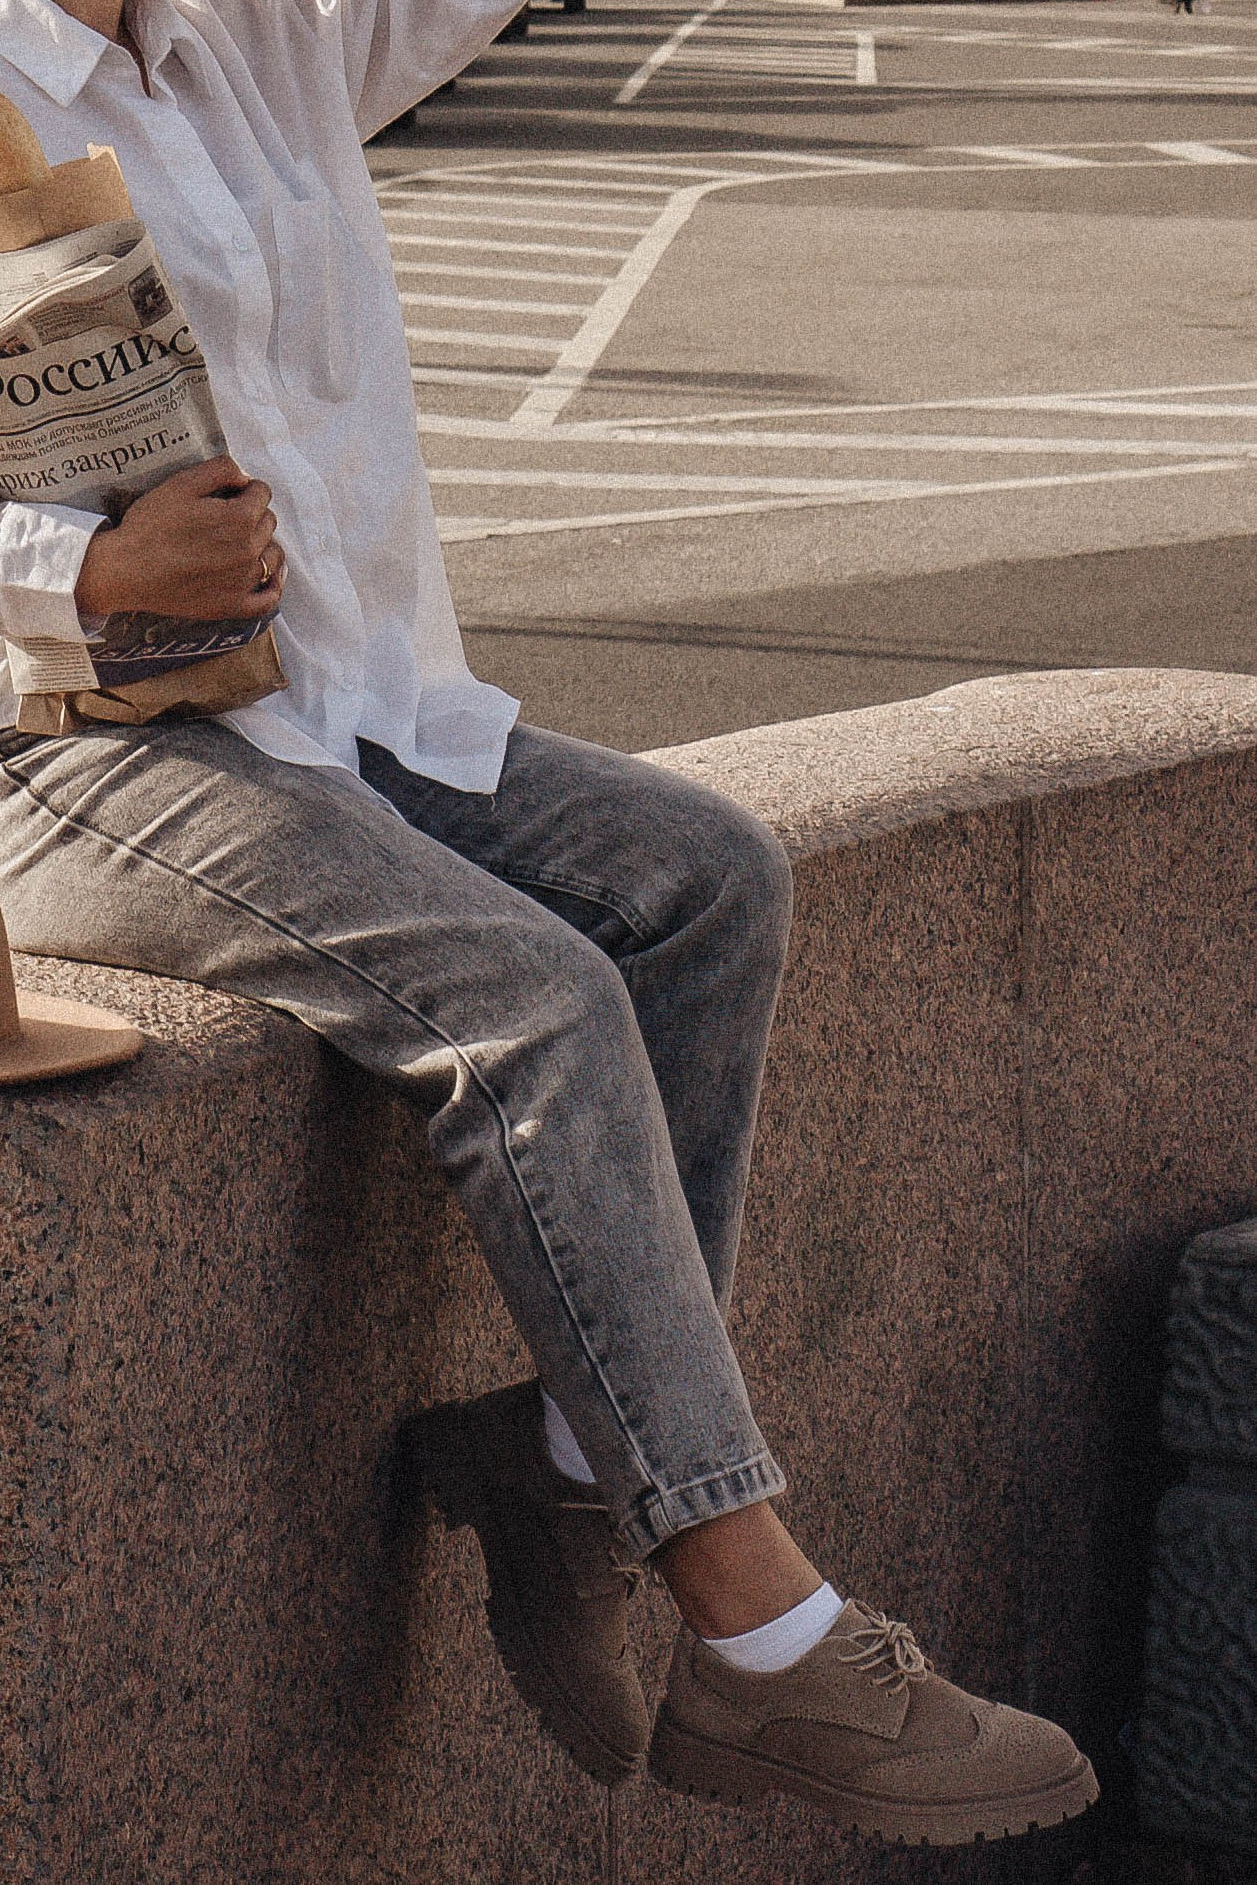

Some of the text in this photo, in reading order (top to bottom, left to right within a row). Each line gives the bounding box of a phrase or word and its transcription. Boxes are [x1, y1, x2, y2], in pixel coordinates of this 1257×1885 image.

[6, 439, 34, 452] МОК
[33, 434, 47, 446] не
[106, 400, 153, 428] россиян
[154, 393, 168, 406] на
[38, 435, 83, 457] попасть
[84, 432, 98, 442] на
[61, 429, 190, 478] закрыт...
